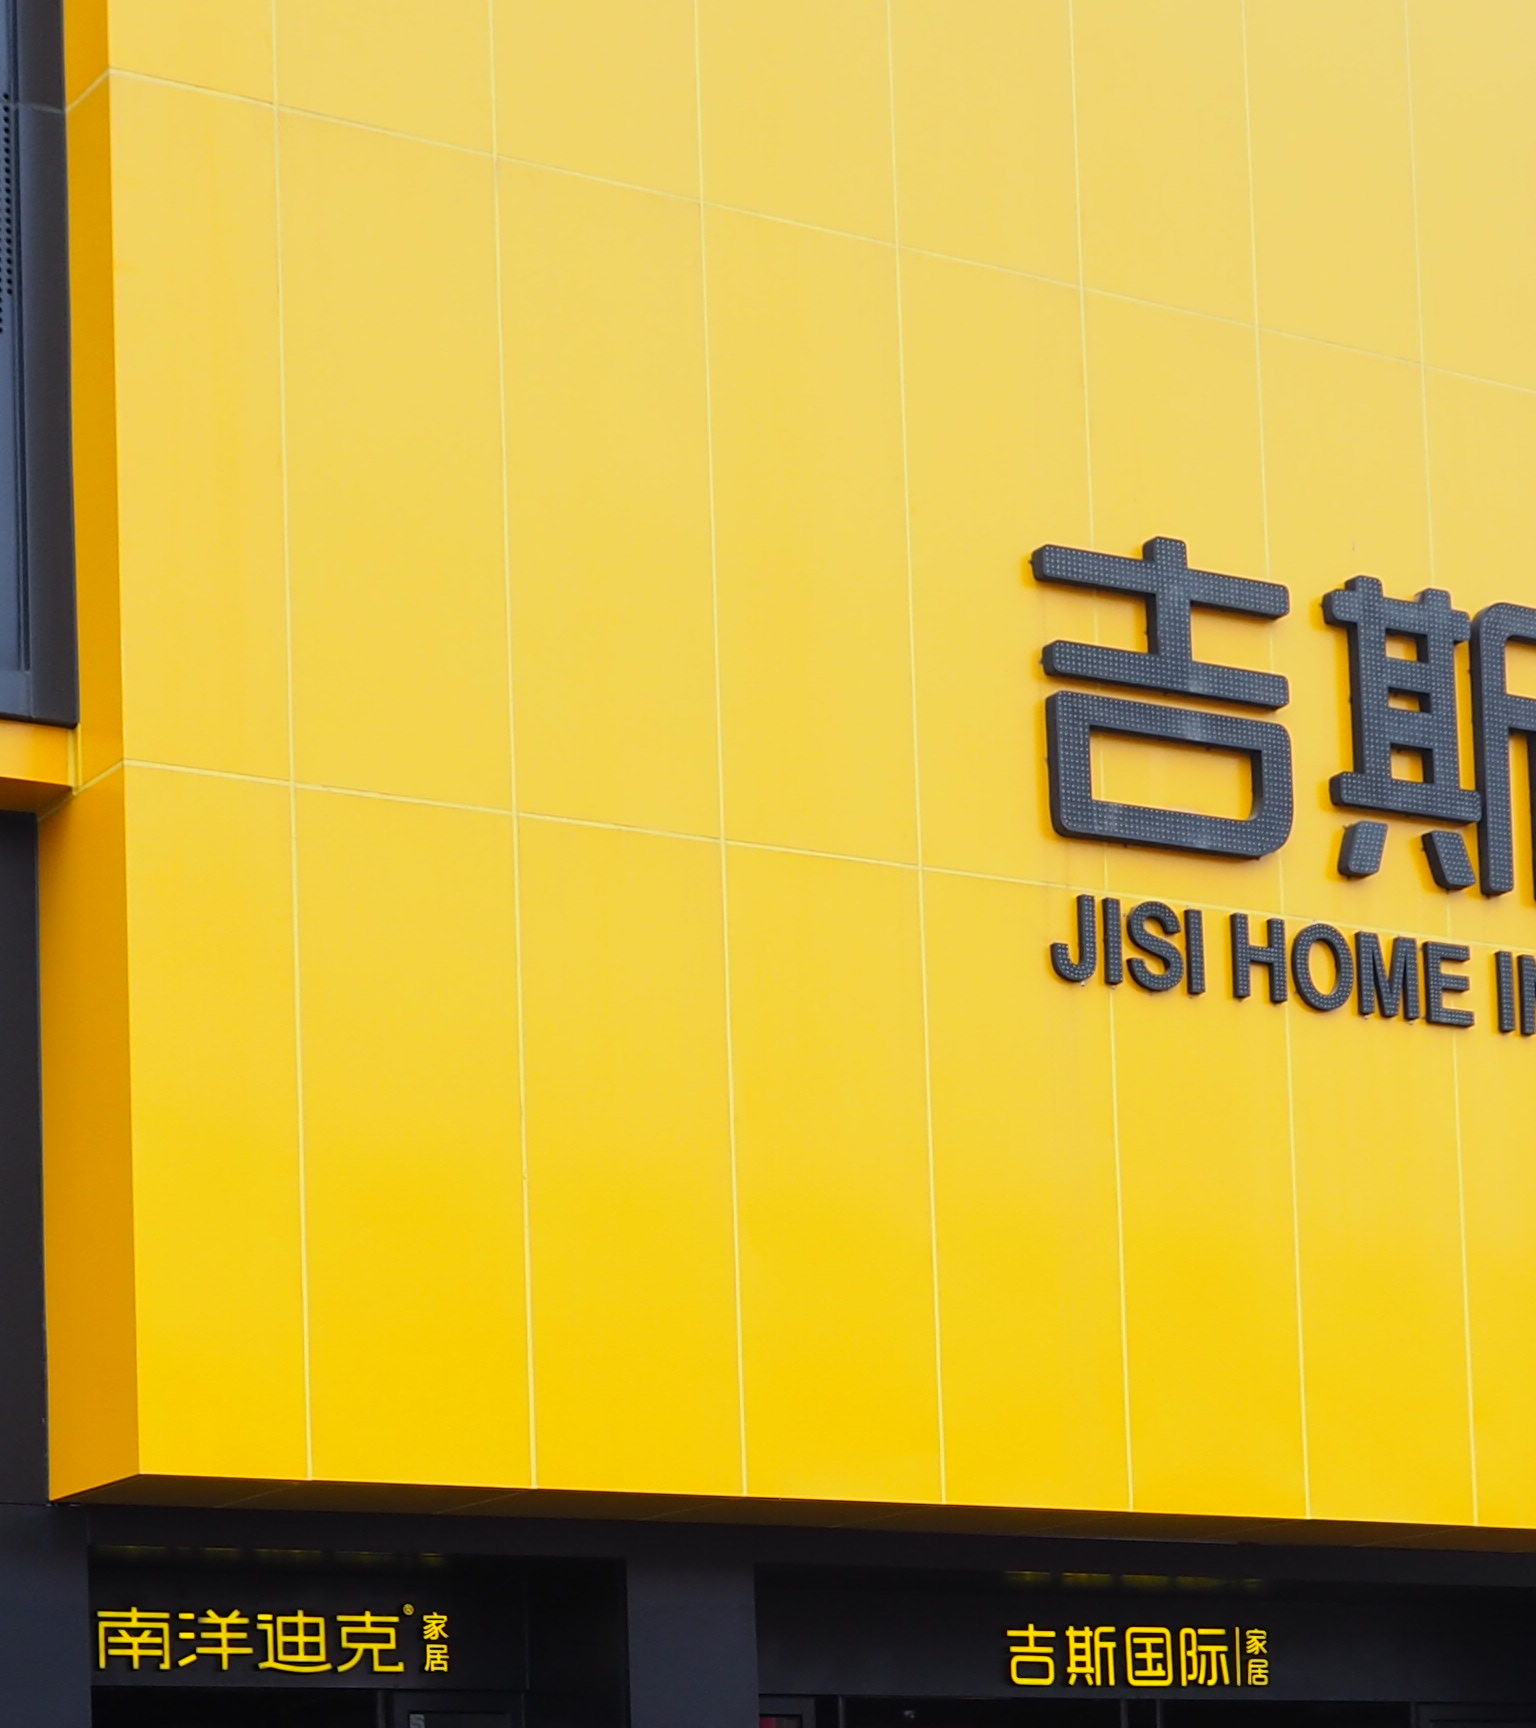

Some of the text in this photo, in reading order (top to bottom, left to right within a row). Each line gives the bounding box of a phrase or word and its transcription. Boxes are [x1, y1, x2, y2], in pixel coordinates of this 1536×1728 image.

[1050, 893, 1205, 996] JISI
[1230, 911, 1473, 1029] HOME
[97, 1607, 405, 1673] 南洋迪克
[423, 1612, 450, 1673] 家居
[1006, 1624, 1231, 1688] 吉斯国际
[1244, 1628, 1270, 1688] 家居
